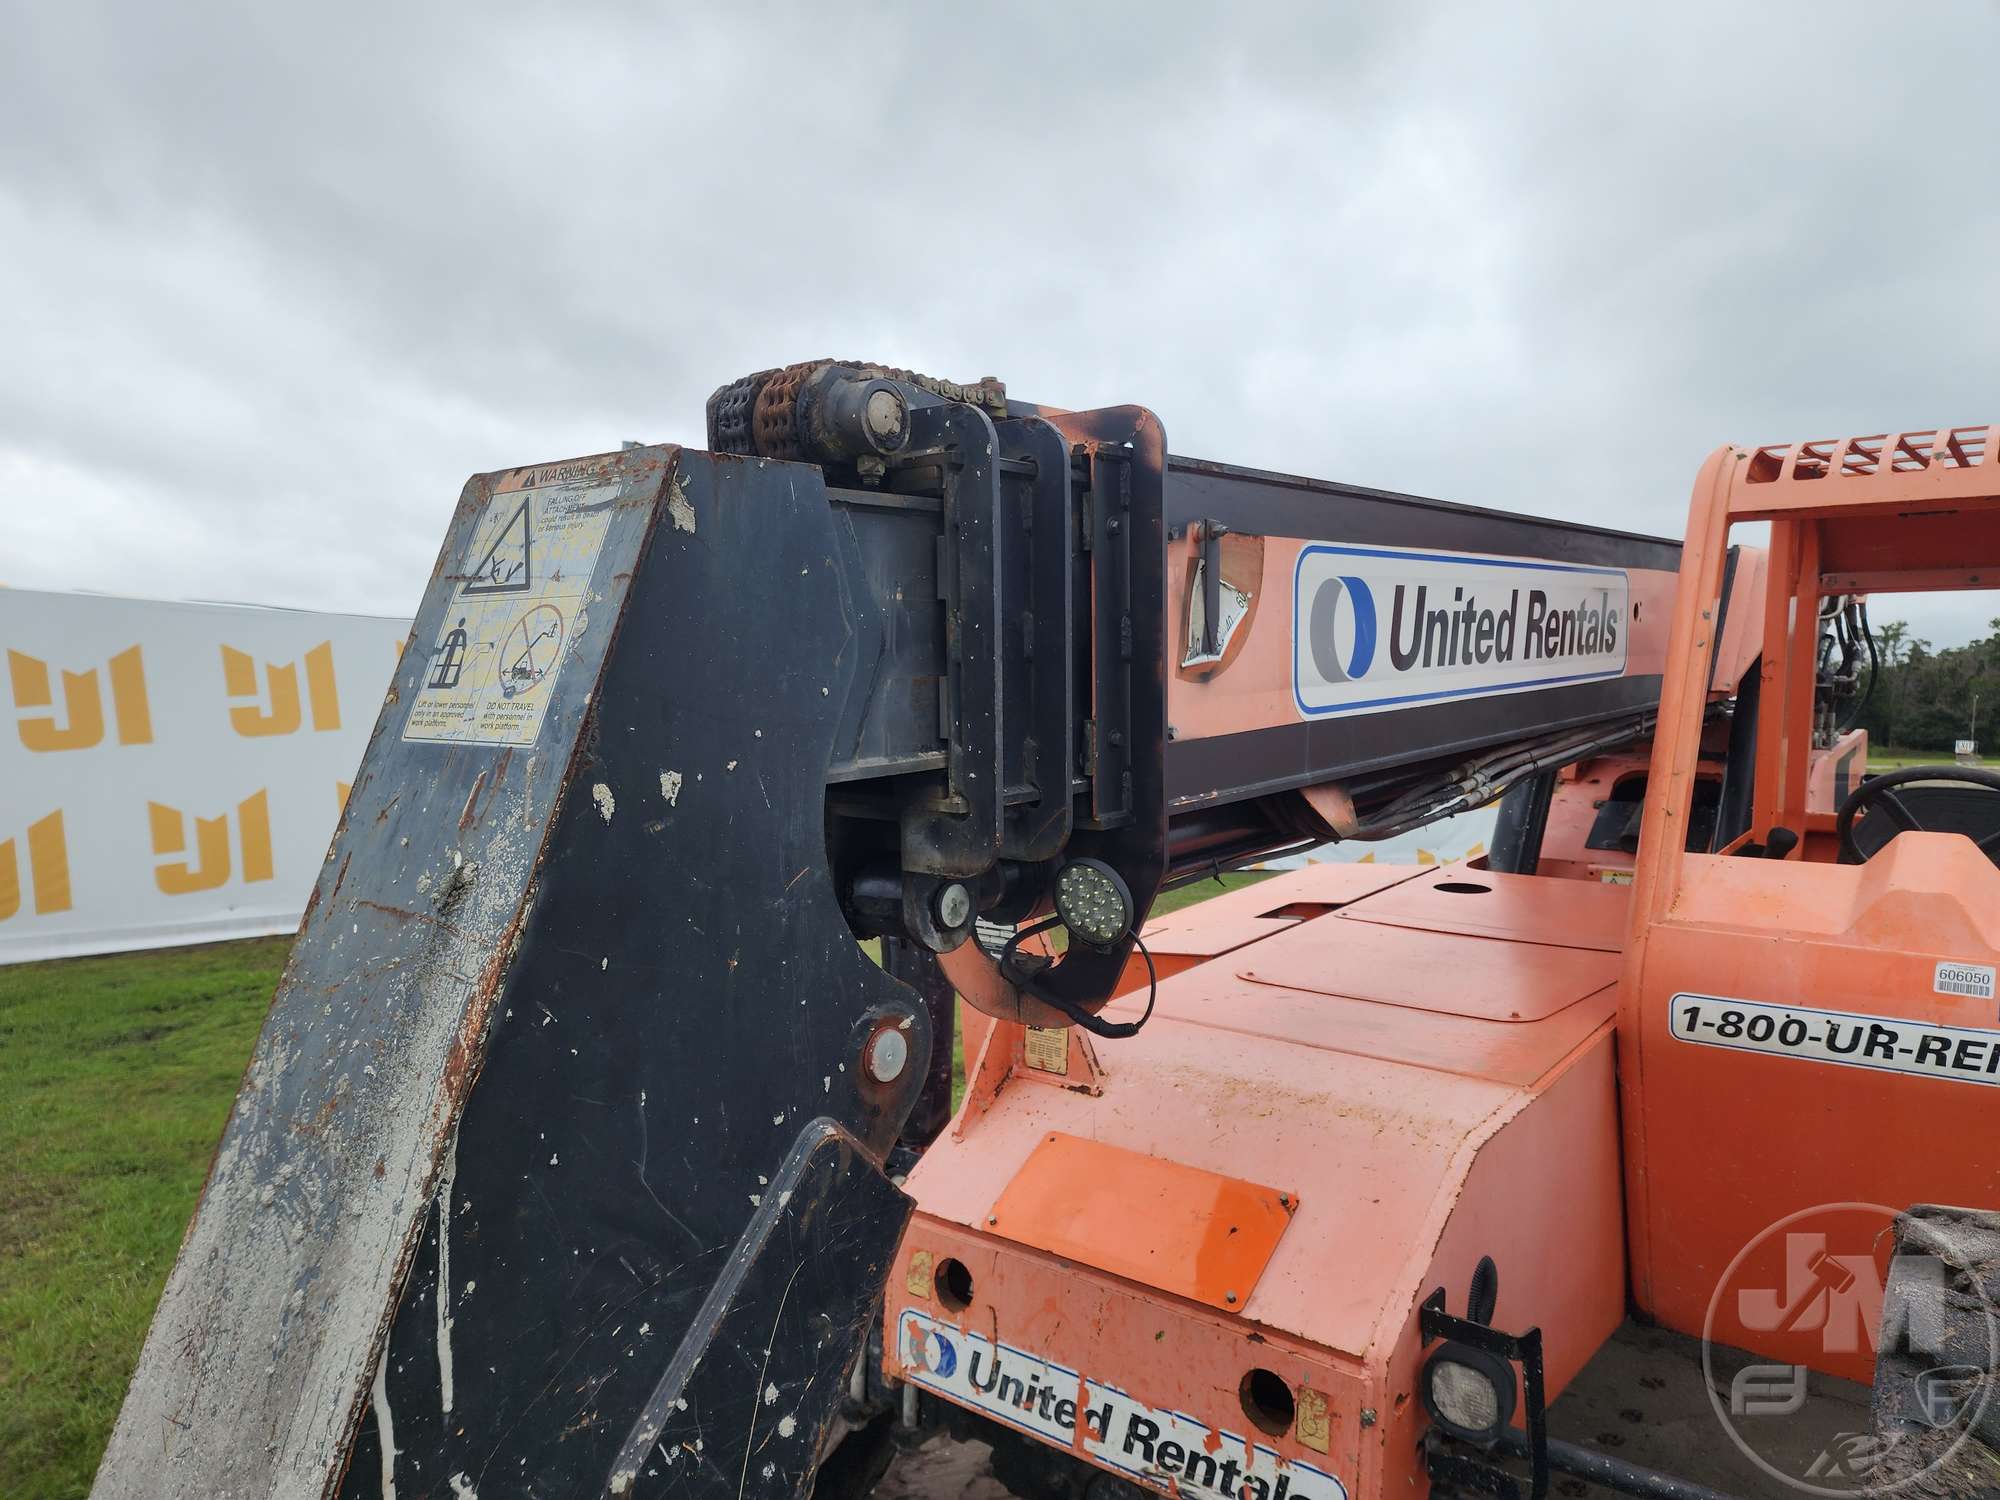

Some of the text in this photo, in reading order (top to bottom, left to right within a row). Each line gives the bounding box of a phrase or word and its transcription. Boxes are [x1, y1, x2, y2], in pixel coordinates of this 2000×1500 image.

[540, 464, 595, 482] WARNING
[1389, 585, 1618, 671] United Rentals
[486, 702, 534, 711] DO NOT TRAVEL
[1939, 968, 1990, 985] 606050
[968, 1351, 1314, 1500] United Rental
